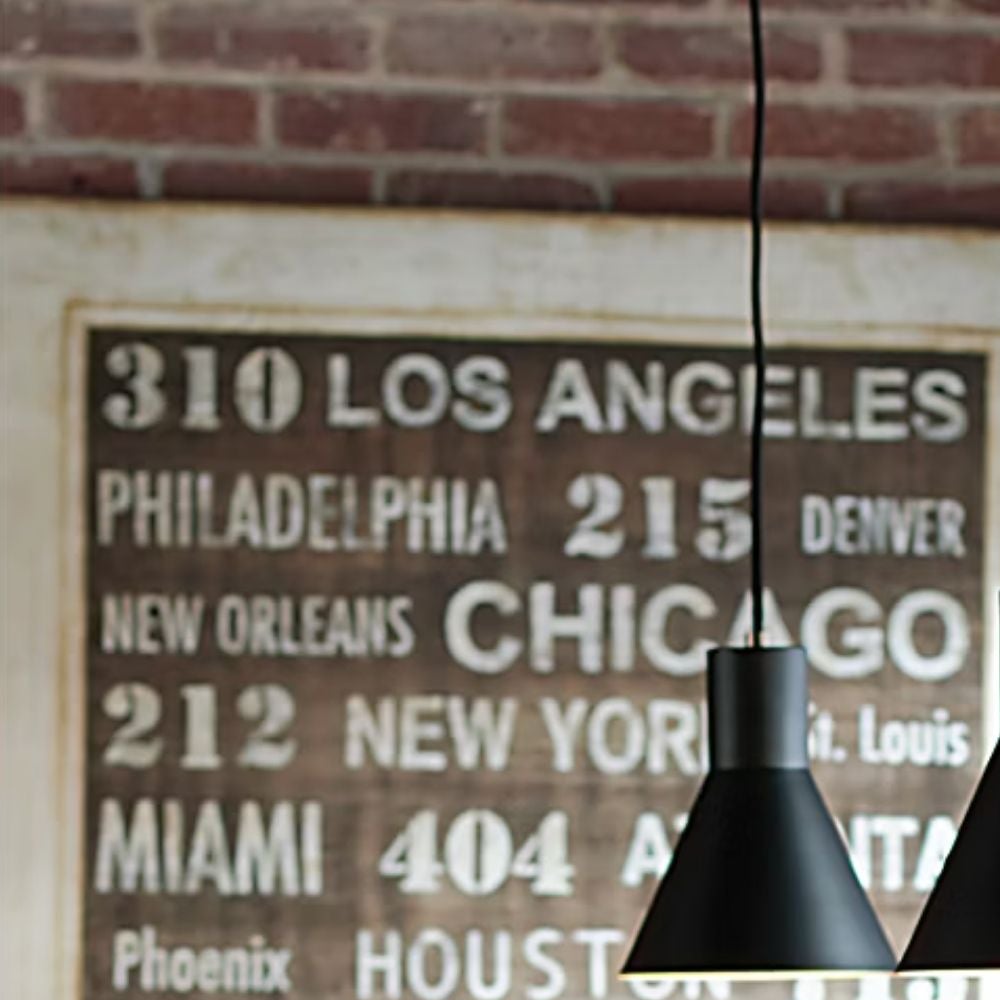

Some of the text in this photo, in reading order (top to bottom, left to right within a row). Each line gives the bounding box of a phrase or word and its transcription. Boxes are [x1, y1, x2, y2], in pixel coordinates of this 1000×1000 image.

[105, 341, 303, 433] 310
[326, 352, 969, 443] LOS ANGELES
[97, 469, 507, 555] PHILADELPHIA
[563, 472, 753, 561] 215
[801, 493, 967, 558] DENVER
[100, 592, 416, 659] NEW ORLEANS
[443, 579, 970, 682] CHICAGO
[103, 682, 297, 770] 212
[343, 694, 709, 776] NEW YOR
[858, 703, 971, 768] Louis
[95, 797, 323, 897] MIAMI
[379, 808, 575, 897] 404
[112, 925, 293, 994] Phoenix
